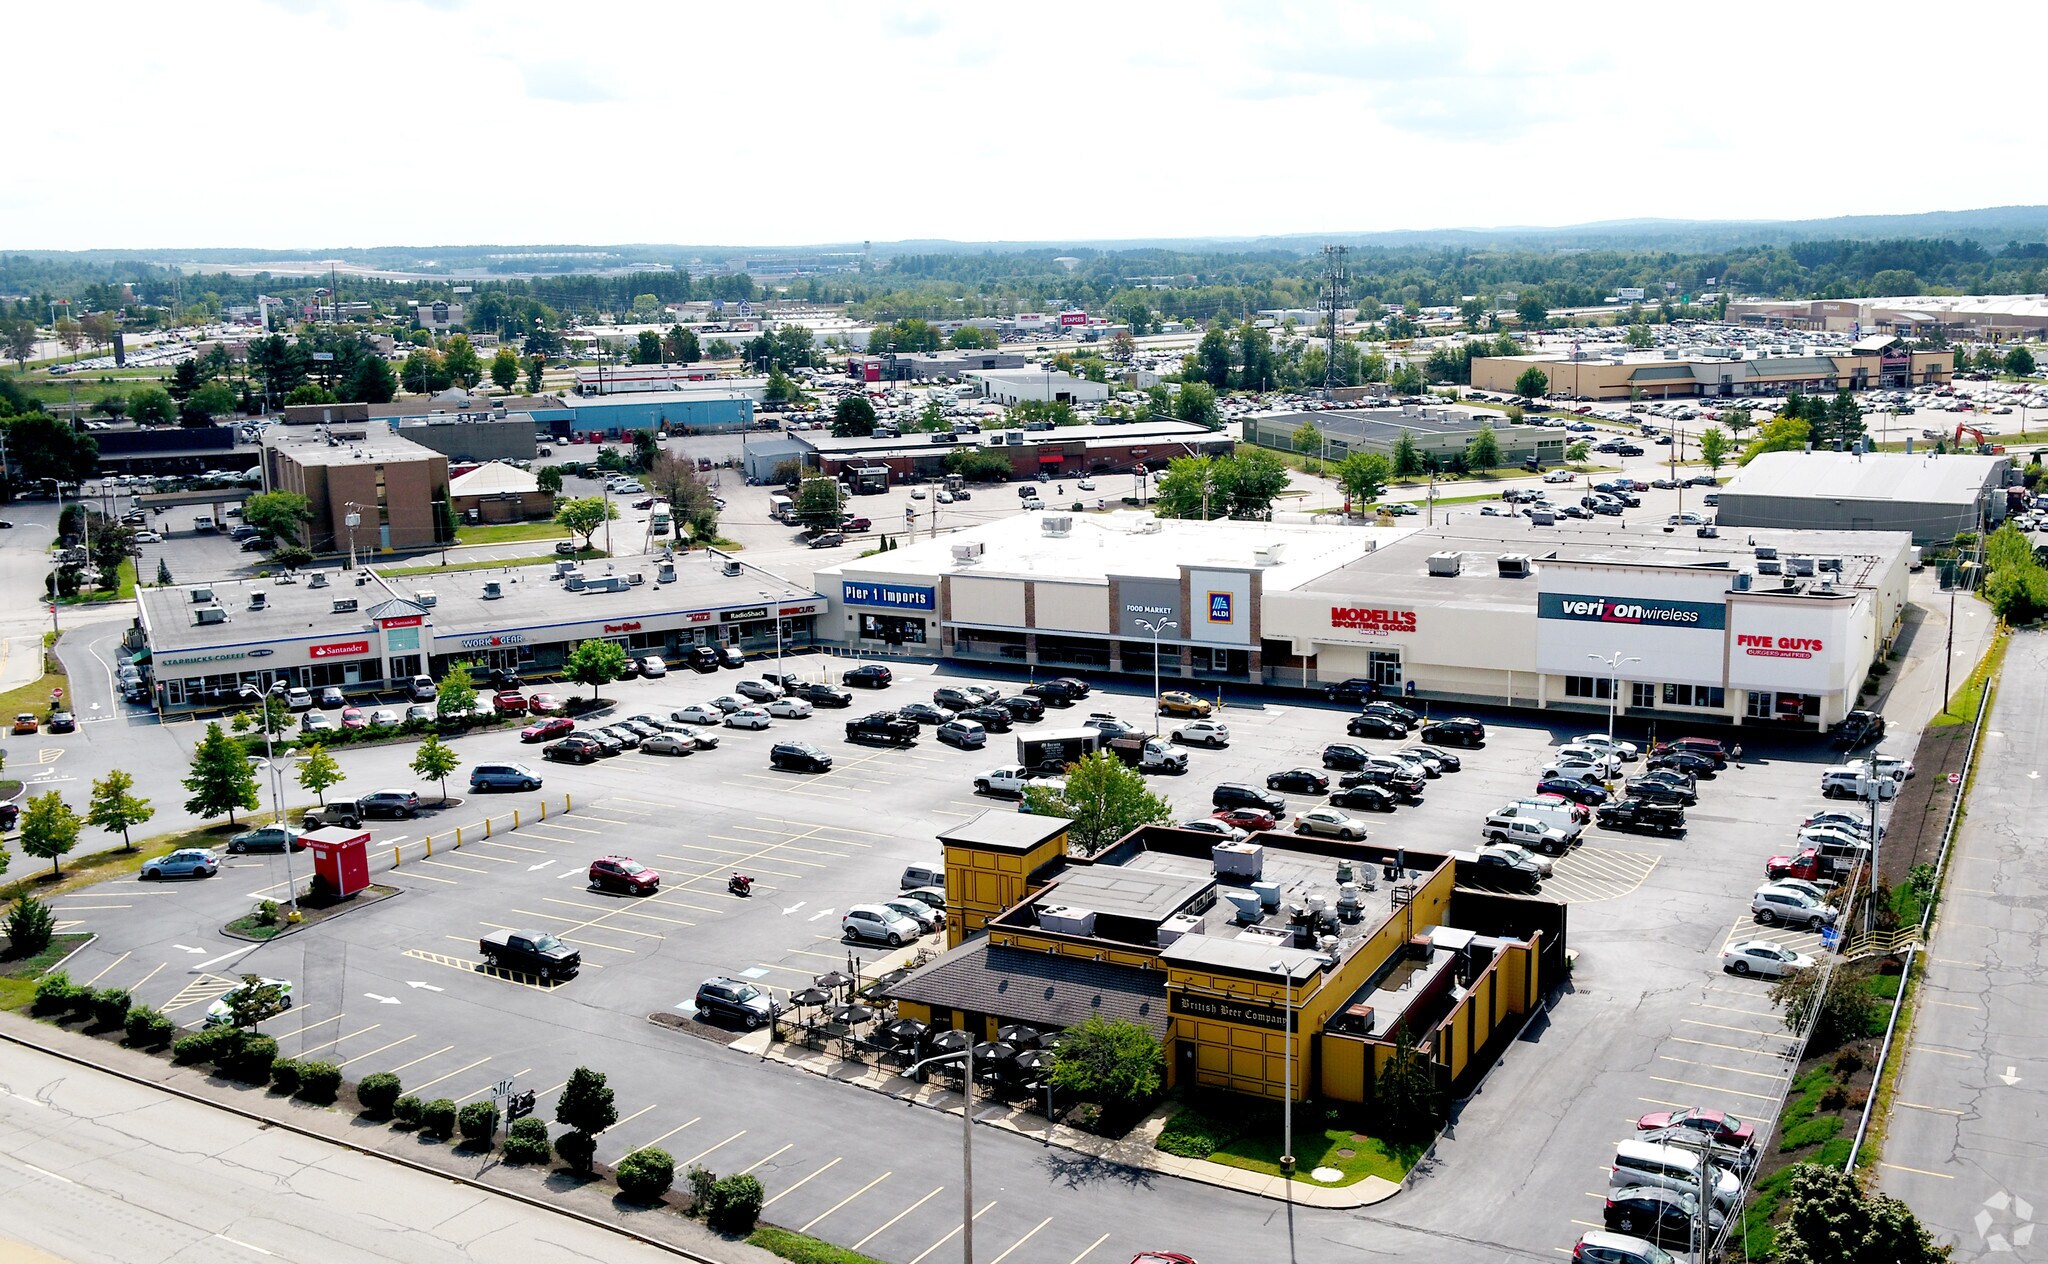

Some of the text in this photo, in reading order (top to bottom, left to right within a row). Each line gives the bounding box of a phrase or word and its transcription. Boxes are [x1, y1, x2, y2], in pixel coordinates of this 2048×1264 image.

[1063, 316, 1085, 324] STAPLES
[845, 585, 869, 600] Pier
[873, 588, 878, 601] 1
[730, 609, 766, 620] RadioShack
[1126, 604, 1172, 614] FOOD MARKET
[1211, 610, 1229, 618] ALDI
[1562, 598, 1699, 623] verizon wireless
[1331, 607, 1417, 625] MODELL'S
[393, 619, 417, 627] Santander
[1331, 620, 1416, 632] SPORTING GOODS
[463, 637, 492, 648] WORK
[500, 634, 523, 645] GEAR
[1737, 634, 1823, 651] FIVE GUYS
[326, 645, 363, 655] Santander
[1748, 649, 1780, 657] BURGERS
[162, 655, 213, 667] STARBUCKS
[215, 652, 246, 661] COFFEE
[1181, 998, 1288, 1027] British Beer Company
